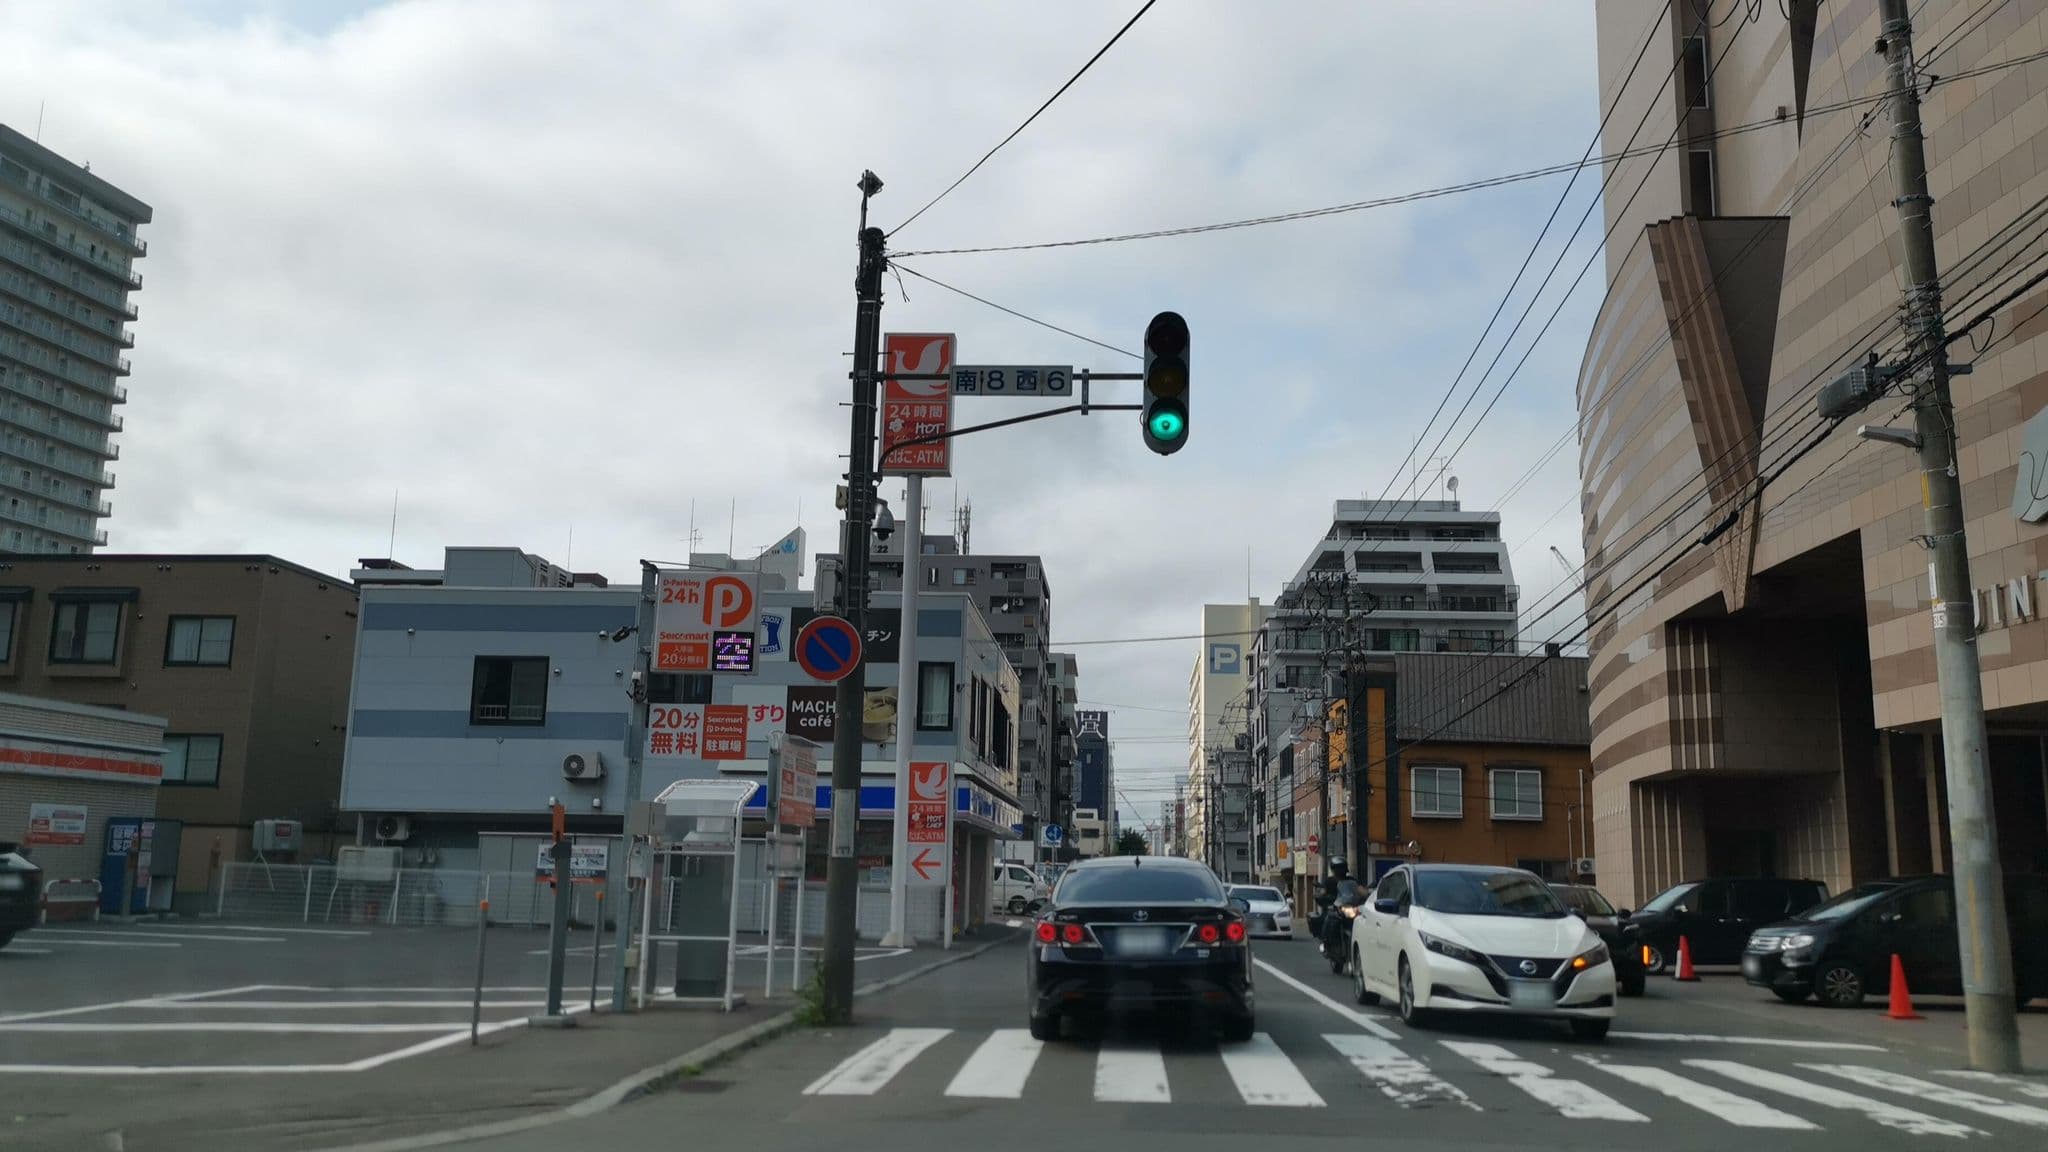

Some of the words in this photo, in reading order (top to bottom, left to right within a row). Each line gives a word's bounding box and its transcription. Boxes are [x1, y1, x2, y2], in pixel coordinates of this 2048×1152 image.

[915, 422, 945, 435] HOT
[661, 588, 699, 604] 24h
[1214, 647, 1237, 671] P
[651, 708, 700, 729] 20分
[751, 704, 785, 722] すり
[799, 714, 832, 727] café
[650, 731, 698, 754] 無料
[706, 739, 742, 752] 駐車場
